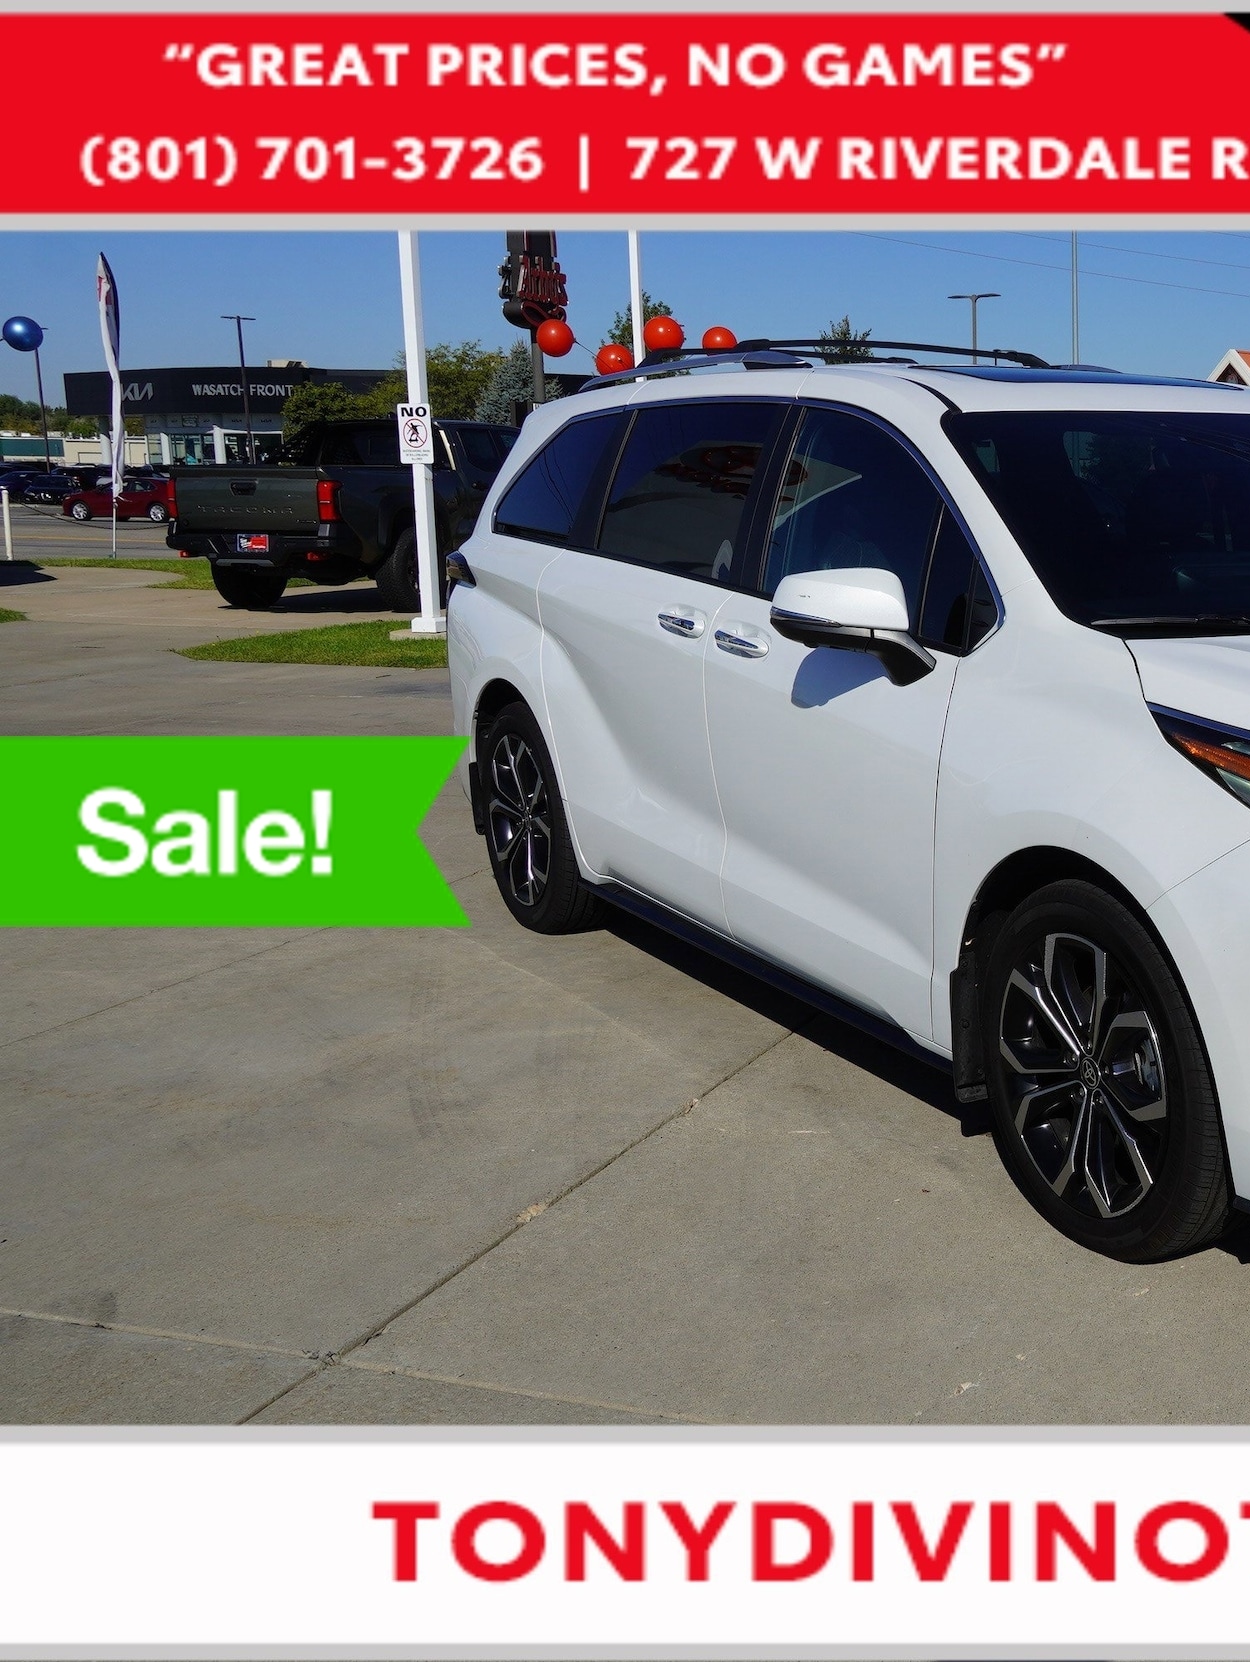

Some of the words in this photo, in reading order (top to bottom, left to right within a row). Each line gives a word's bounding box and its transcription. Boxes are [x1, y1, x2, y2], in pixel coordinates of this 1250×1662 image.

[191, 384, 244, 396] WASATCH
[249, 384, 294, 397] FRONT
[401, 406, 427, 418] NO
